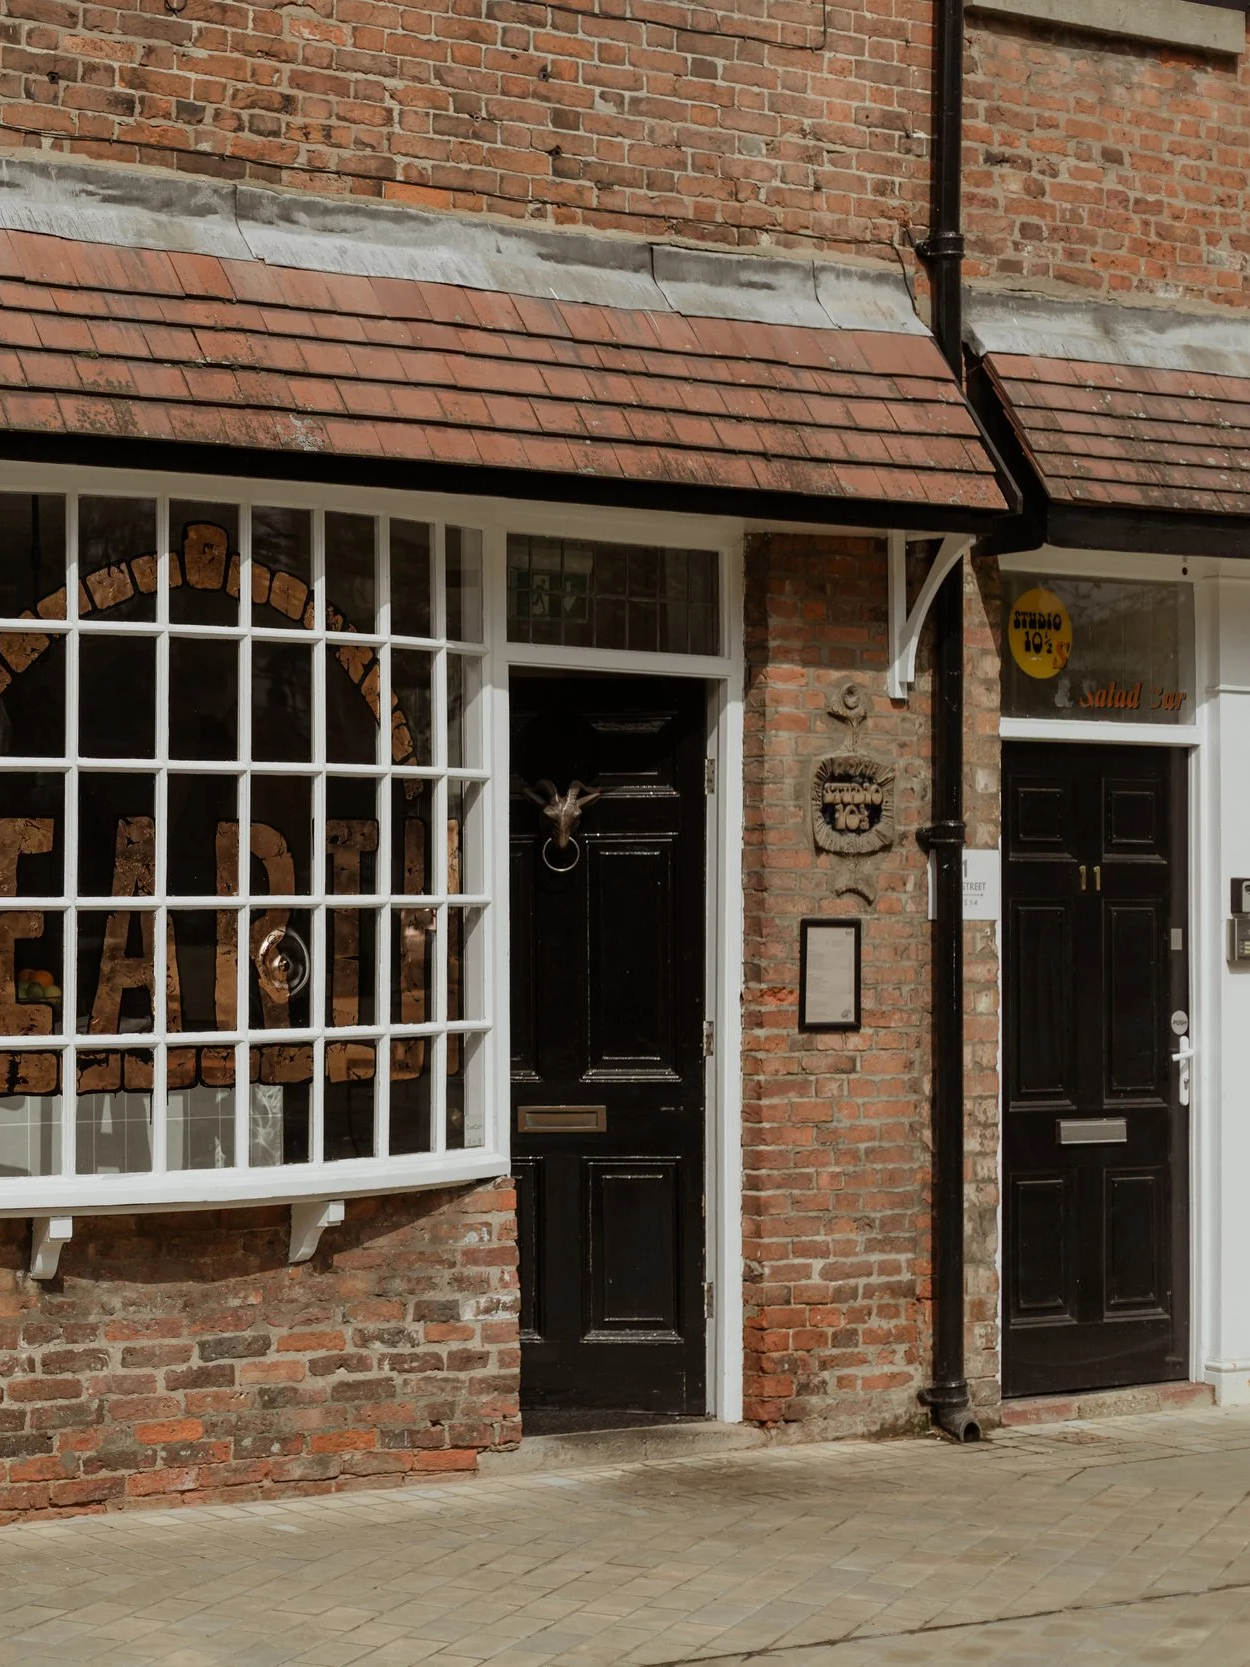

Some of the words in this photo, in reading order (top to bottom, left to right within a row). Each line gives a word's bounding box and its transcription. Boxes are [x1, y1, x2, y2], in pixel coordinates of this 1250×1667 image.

[1013, 610, 1063, 632] STUDIO
[823, 782, 883, 805] STUDIO
[1079, 865, 1101, 891] 11
